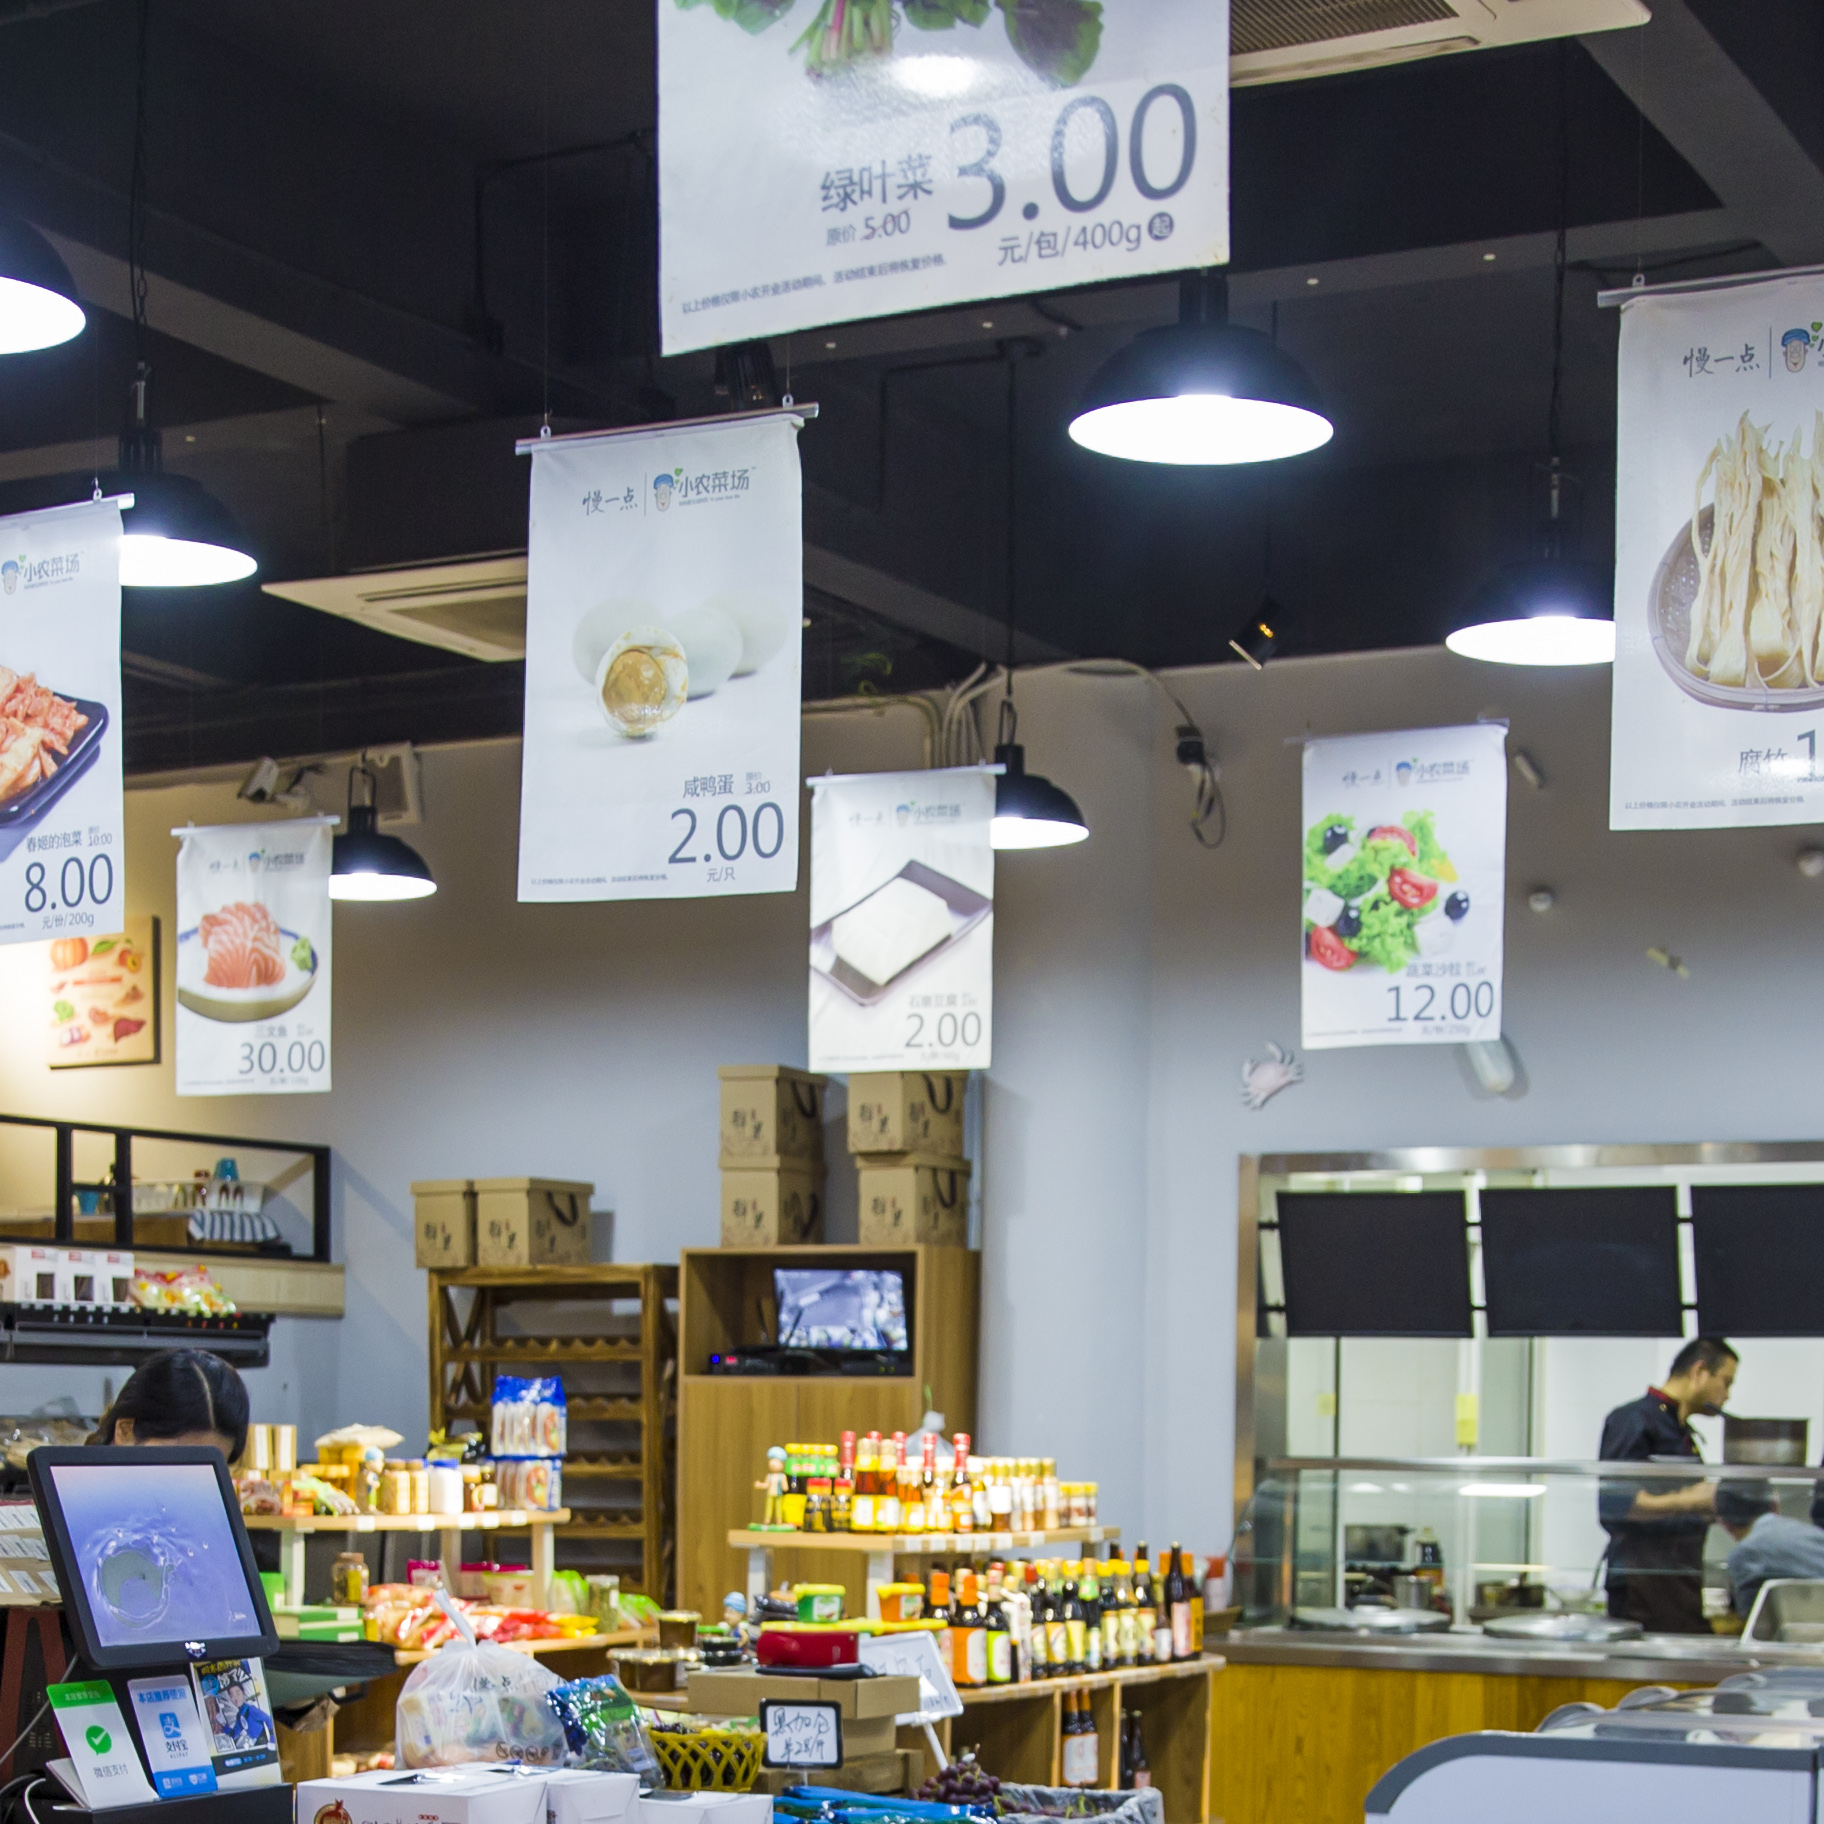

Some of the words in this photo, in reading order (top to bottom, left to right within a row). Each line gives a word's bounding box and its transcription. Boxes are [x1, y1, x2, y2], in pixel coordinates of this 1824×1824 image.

[820, 153, 935, 214] 绿叶菜
[947, 83, 1198, 231] 3.00
[862, 208, 912, 241] 5.00
[998, 219, 1143, 267] 元/包/400g
[1683, 343, 1760, 378] 慢一点
[678, 468, 750, 498] 小农菜场
[582, 486, 638, 516] 慢一点
[23, 553, 80, 582] 小农菜场
[683, 773, 735, 799] 咸鸭蛋
[668, 801, 785, 865] 2.00
[25, 852, 114, 913] 8.00
[707, 866, 736, 883] 元/只
[1386, 981, 1495, 1022] 12.00
[904, 1010, 983, 1049] 2.00
[238, 1039, 326, 1076] 30.00
[165, 1738, 189, 1754] 支付宝
[93, 1763, 129, 1779] 微信支付
